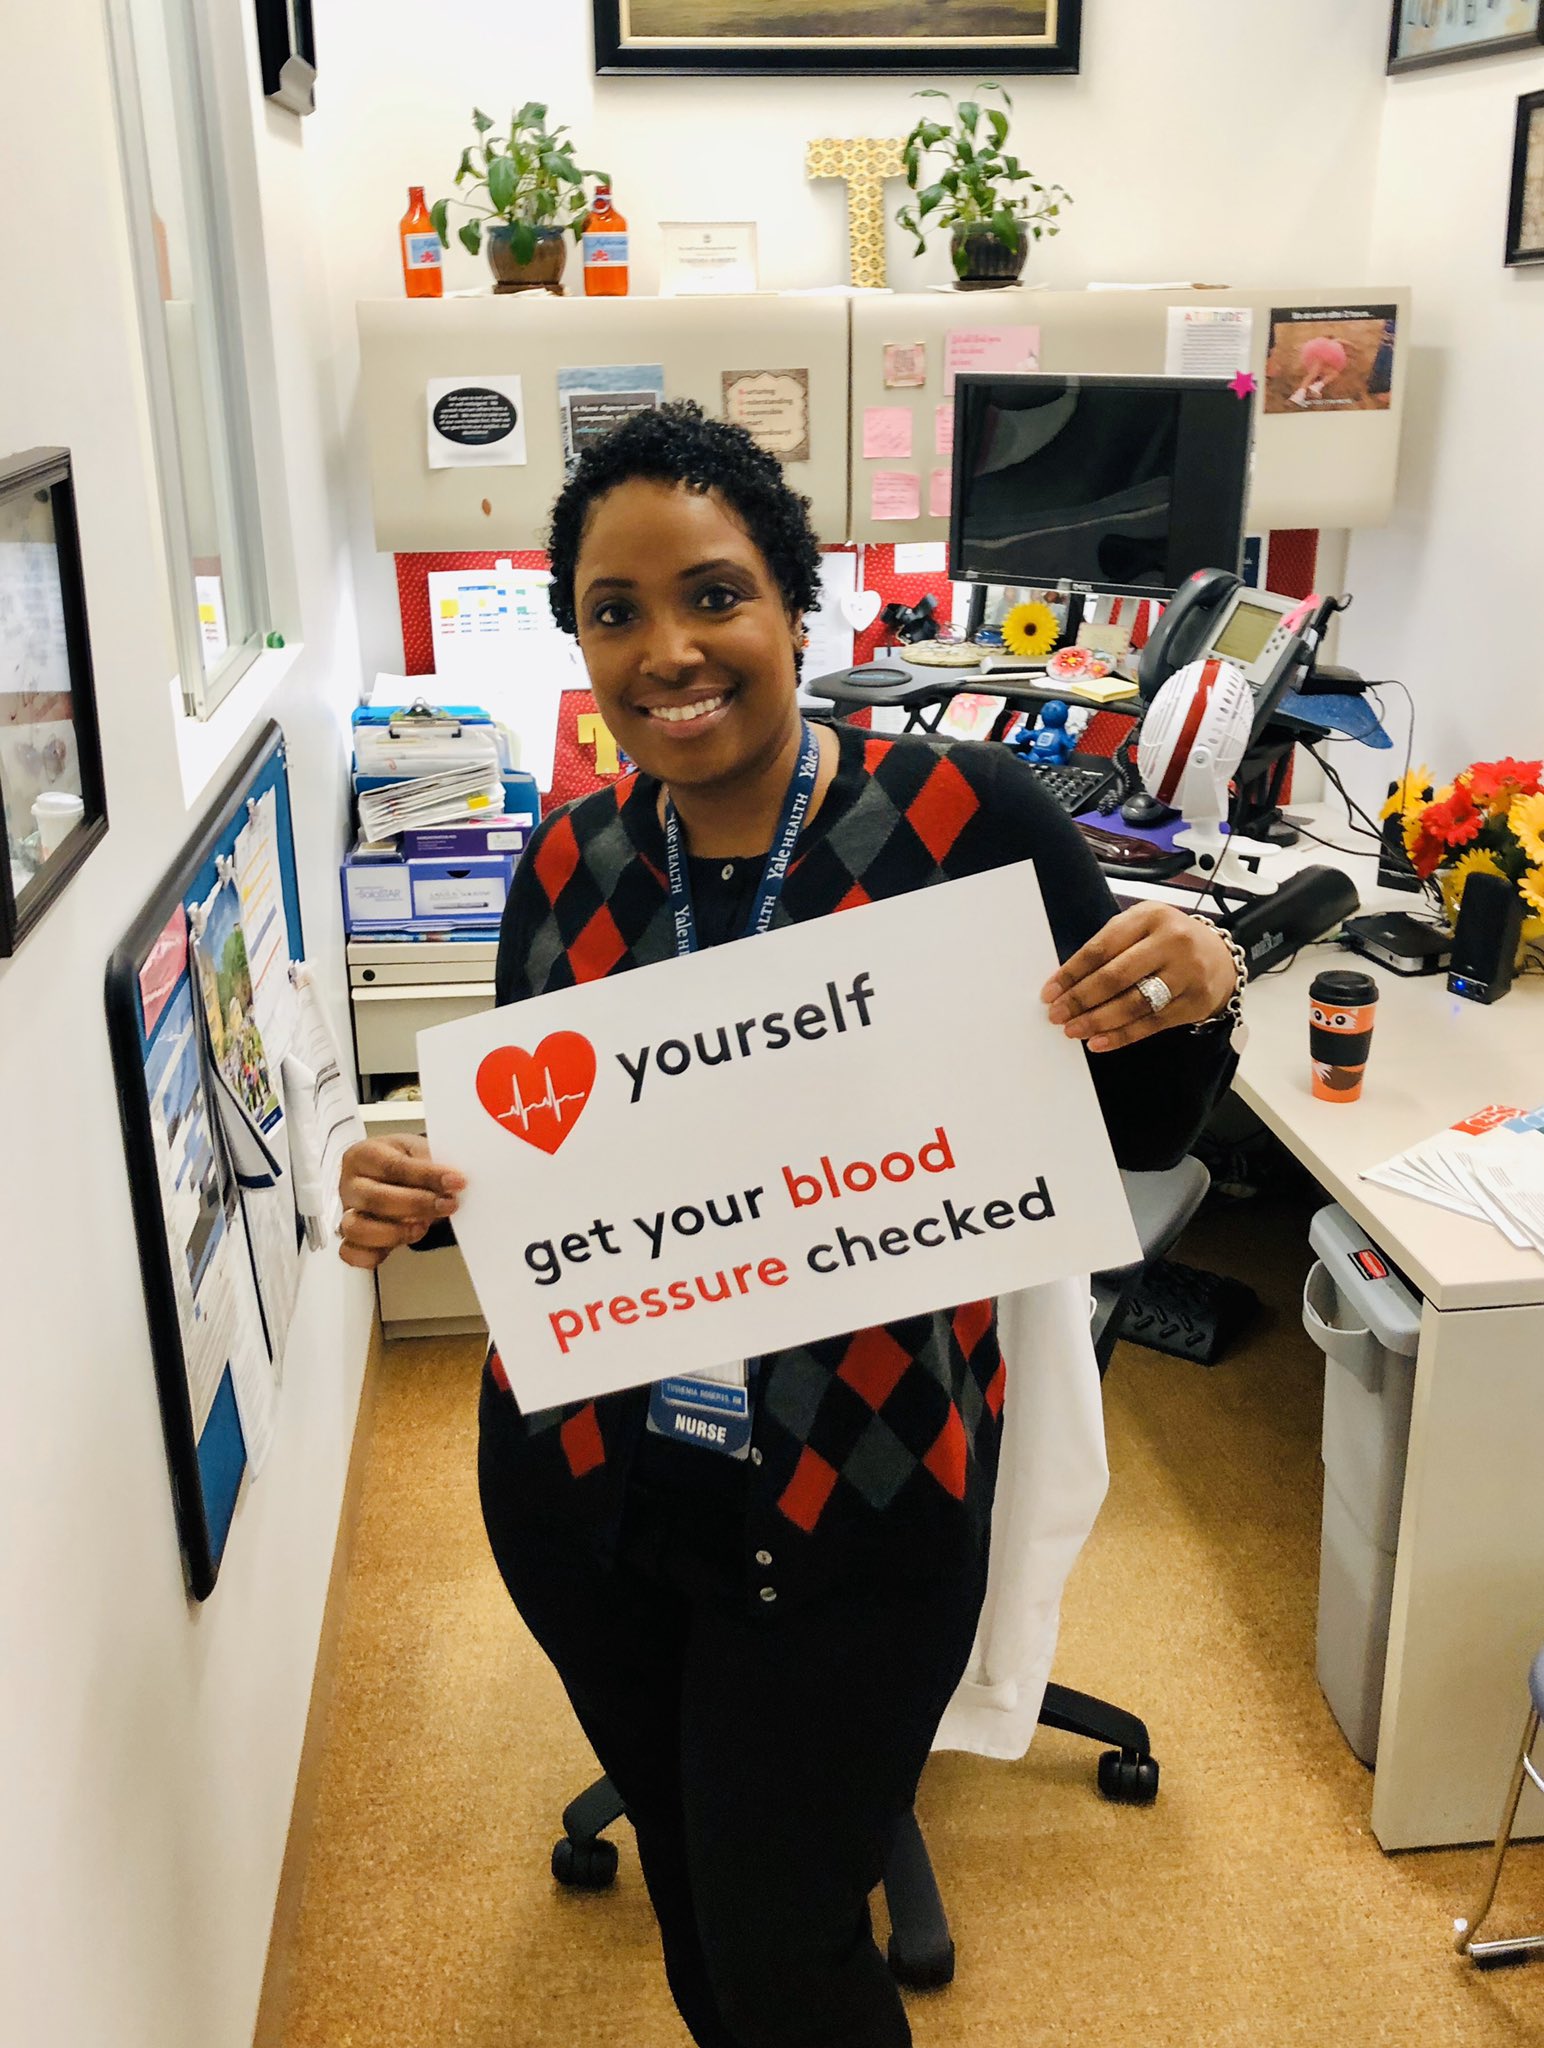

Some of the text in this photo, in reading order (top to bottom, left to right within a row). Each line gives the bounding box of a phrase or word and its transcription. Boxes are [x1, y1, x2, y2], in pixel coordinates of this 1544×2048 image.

[667, 845, 683, 895] HEALTH
[766, 792, 809, 881] Yale HEALTH
[674, 904, 693, 938] Yale
[755, 895, 777, 935] ALTH
[616, 972, 874, 1103] yourself
[525, 1127, 955, 1285] get your blood
[549, 1176, 1055, 1353] pressure checked
[674, 1413, 727, 1446] NURSE
